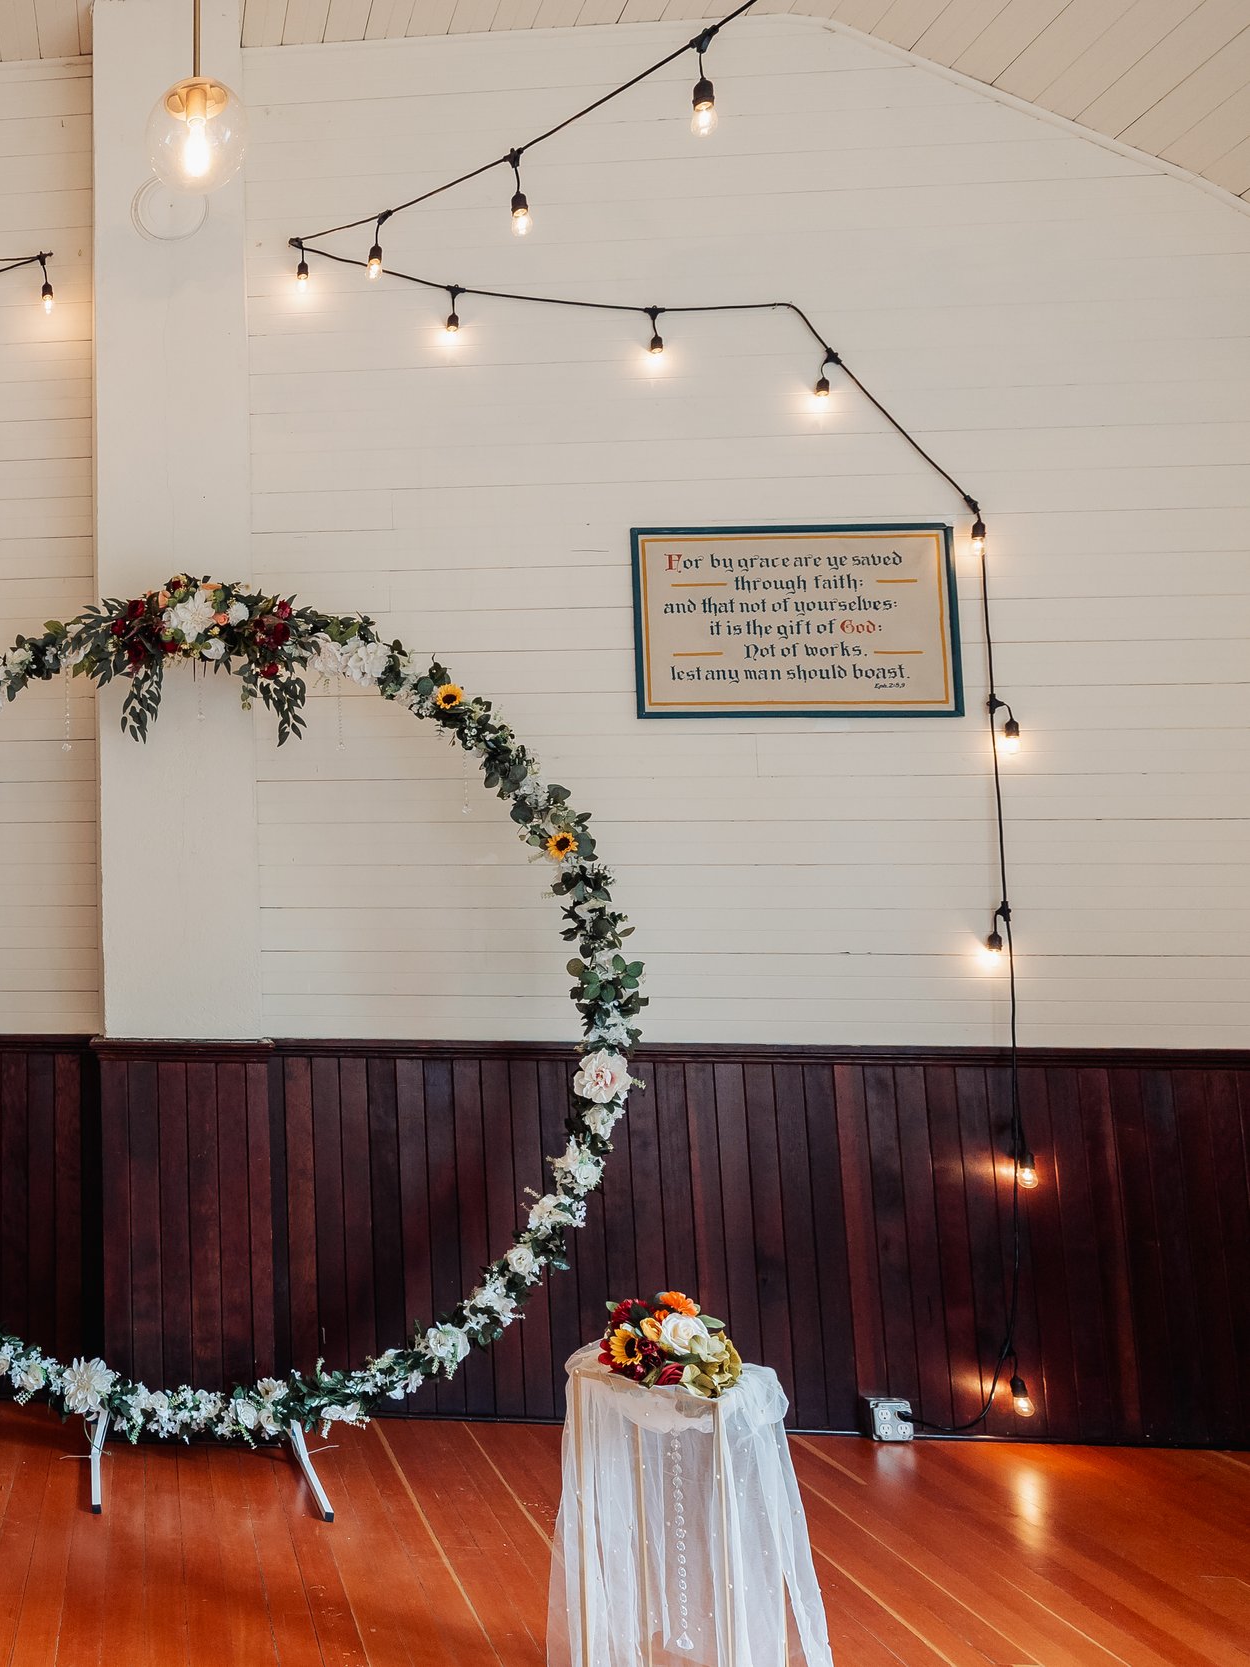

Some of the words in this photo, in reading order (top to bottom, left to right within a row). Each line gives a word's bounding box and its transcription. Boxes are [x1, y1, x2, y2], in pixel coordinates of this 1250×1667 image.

[664, 553, 704, 573] For
[710, 553, 734, 572] by
[738, 555, 790, 572] grace
[794, 554, 822, 567] are
[827, 555, 848, 570] ye
[852, 551, 902, 566] saved
[734, 575, 807, 595] through
[814, 573, 863, 592] faith:
[664, 599, 697, 614] and
[701, 596, 735, 616] that
[739, 599, 766, 613] not
[771, 597, 791, 612] of
[794, 596, 897, 616] yourselves:
[710, 620, 722, 636] it
[726, 620, 742, 636] is
[746, 619, 773, 638] the
[777, 619, 811, 639] gift
[817, 618, 837, 634] of
[840, 620, 882, 634] God:
[744, 644, 776, 660] Not
[781, 643, 799, 657] of
[670, 665, 702, 681] lest
[705, 669, 740, 684] any
[744, 669, 781, 680] man
[787, 664, 847, 683] should
[853, 664, 910, 679] boast.
